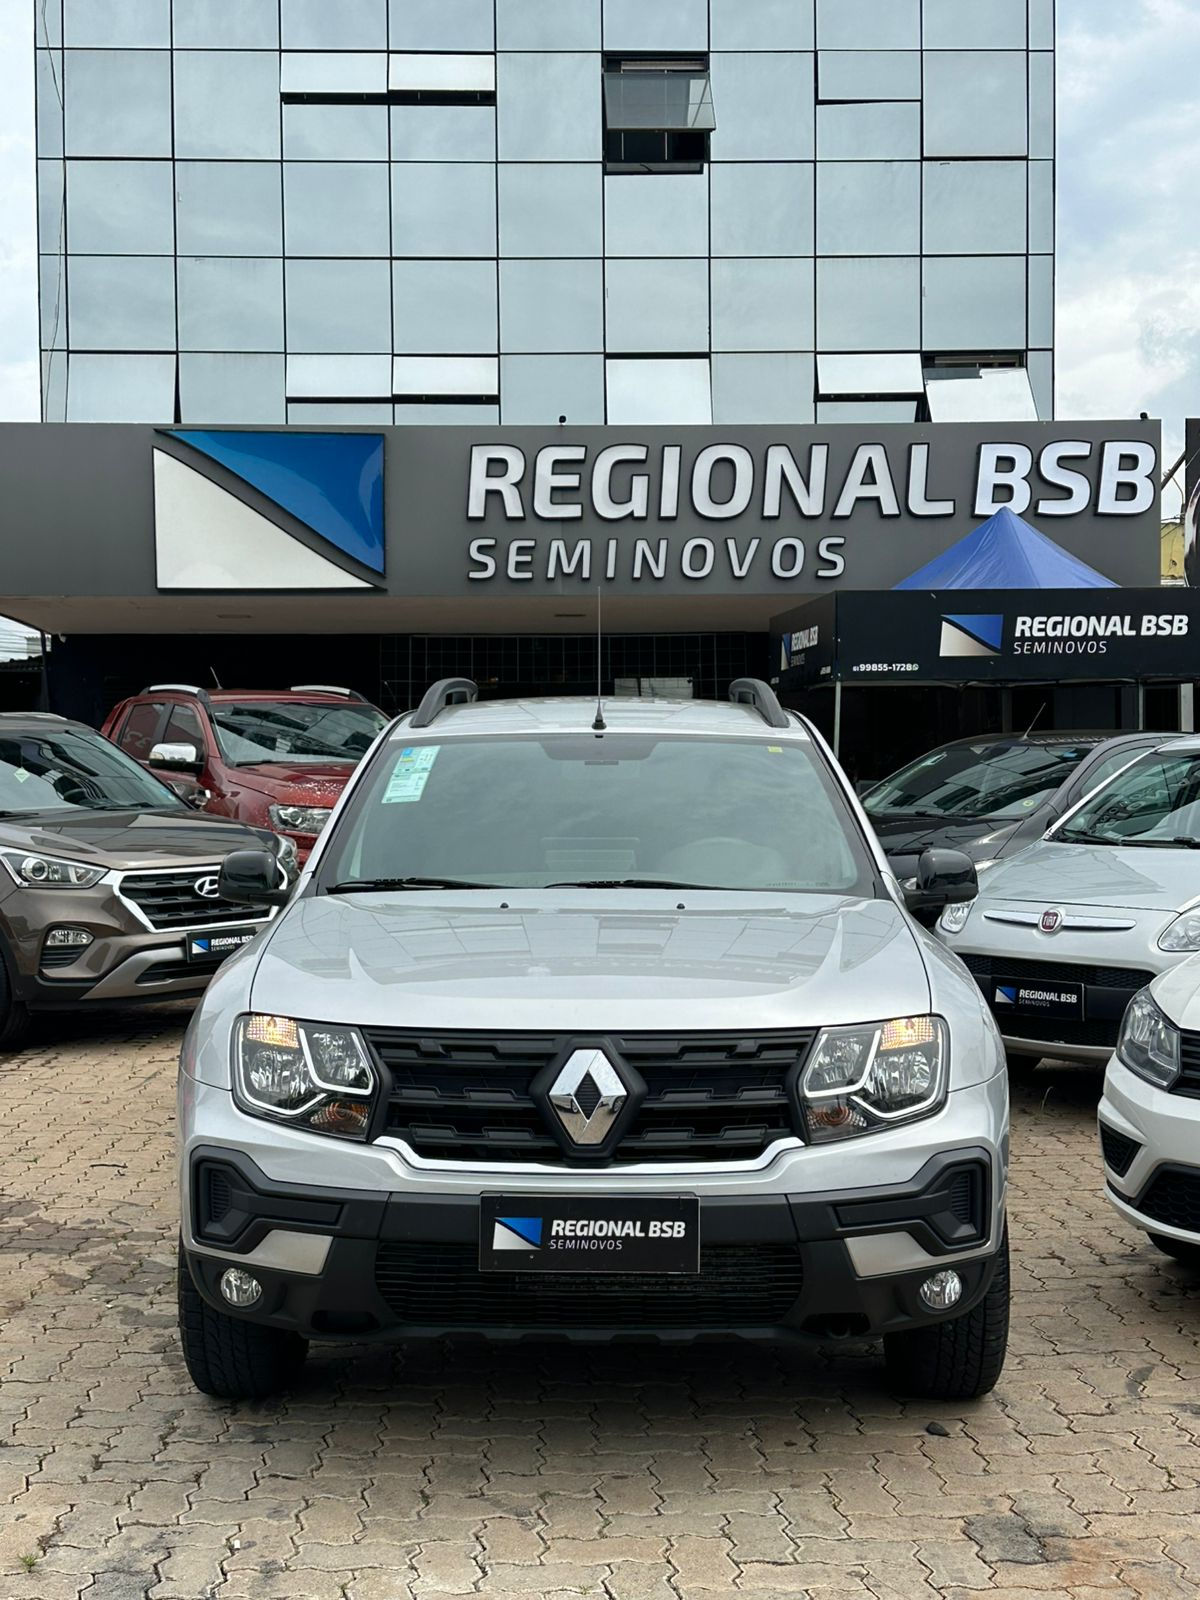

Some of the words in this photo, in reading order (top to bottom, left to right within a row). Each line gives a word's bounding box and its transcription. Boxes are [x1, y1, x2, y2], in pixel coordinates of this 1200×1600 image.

[466, 443, 956, 520] REGIONAL
[973, 440, 1157, 518] BSB
[467, 536, 847, 581] SEMINOVOS
[1014, 615, 1136, 638] REGIONAL
[1140, 614, 1189, 636] BSB
[1013, 640, 1107, 655] SEMINOVOS
[859, 663, 913, 672] 99855-1728
[211, 936, 241, 946] REGIONAL
[1019, 989, 1059, 1002] REGIONAL
[1060, 993, 1078, 1003] BSB
[551, 1219, 645, 1238] REGIONAL
[648, 1220, 686, 1238] BSB
[549, 1239, 623, 1250] SEMINOVOS
